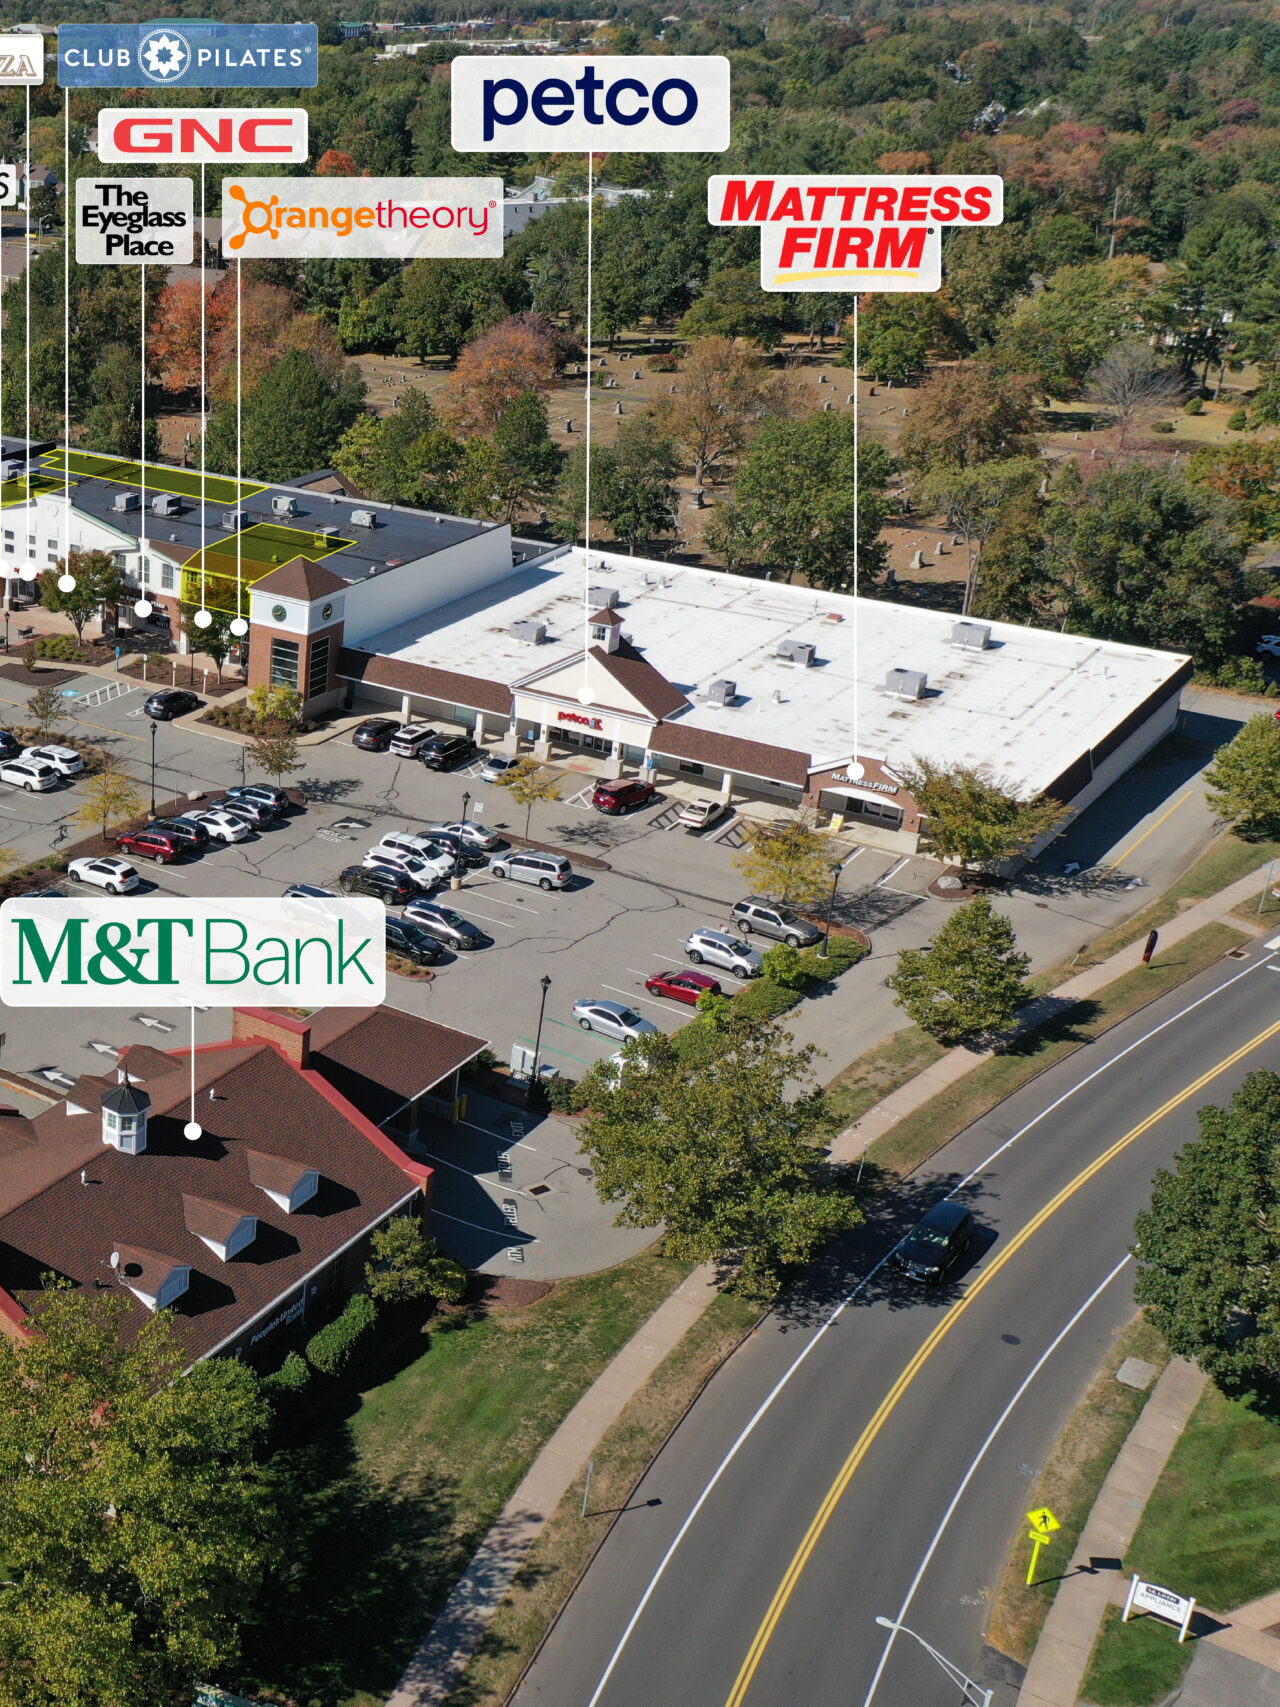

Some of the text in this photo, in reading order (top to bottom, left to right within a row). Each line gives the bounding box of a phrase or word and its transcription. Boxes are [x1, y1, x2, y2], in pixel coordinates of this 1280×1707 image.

[558, 711, 590, 727] petco
[507, 1246, 524, 1263] ATM
[1139, 1592, 1183, 1612] APPLIANCE
